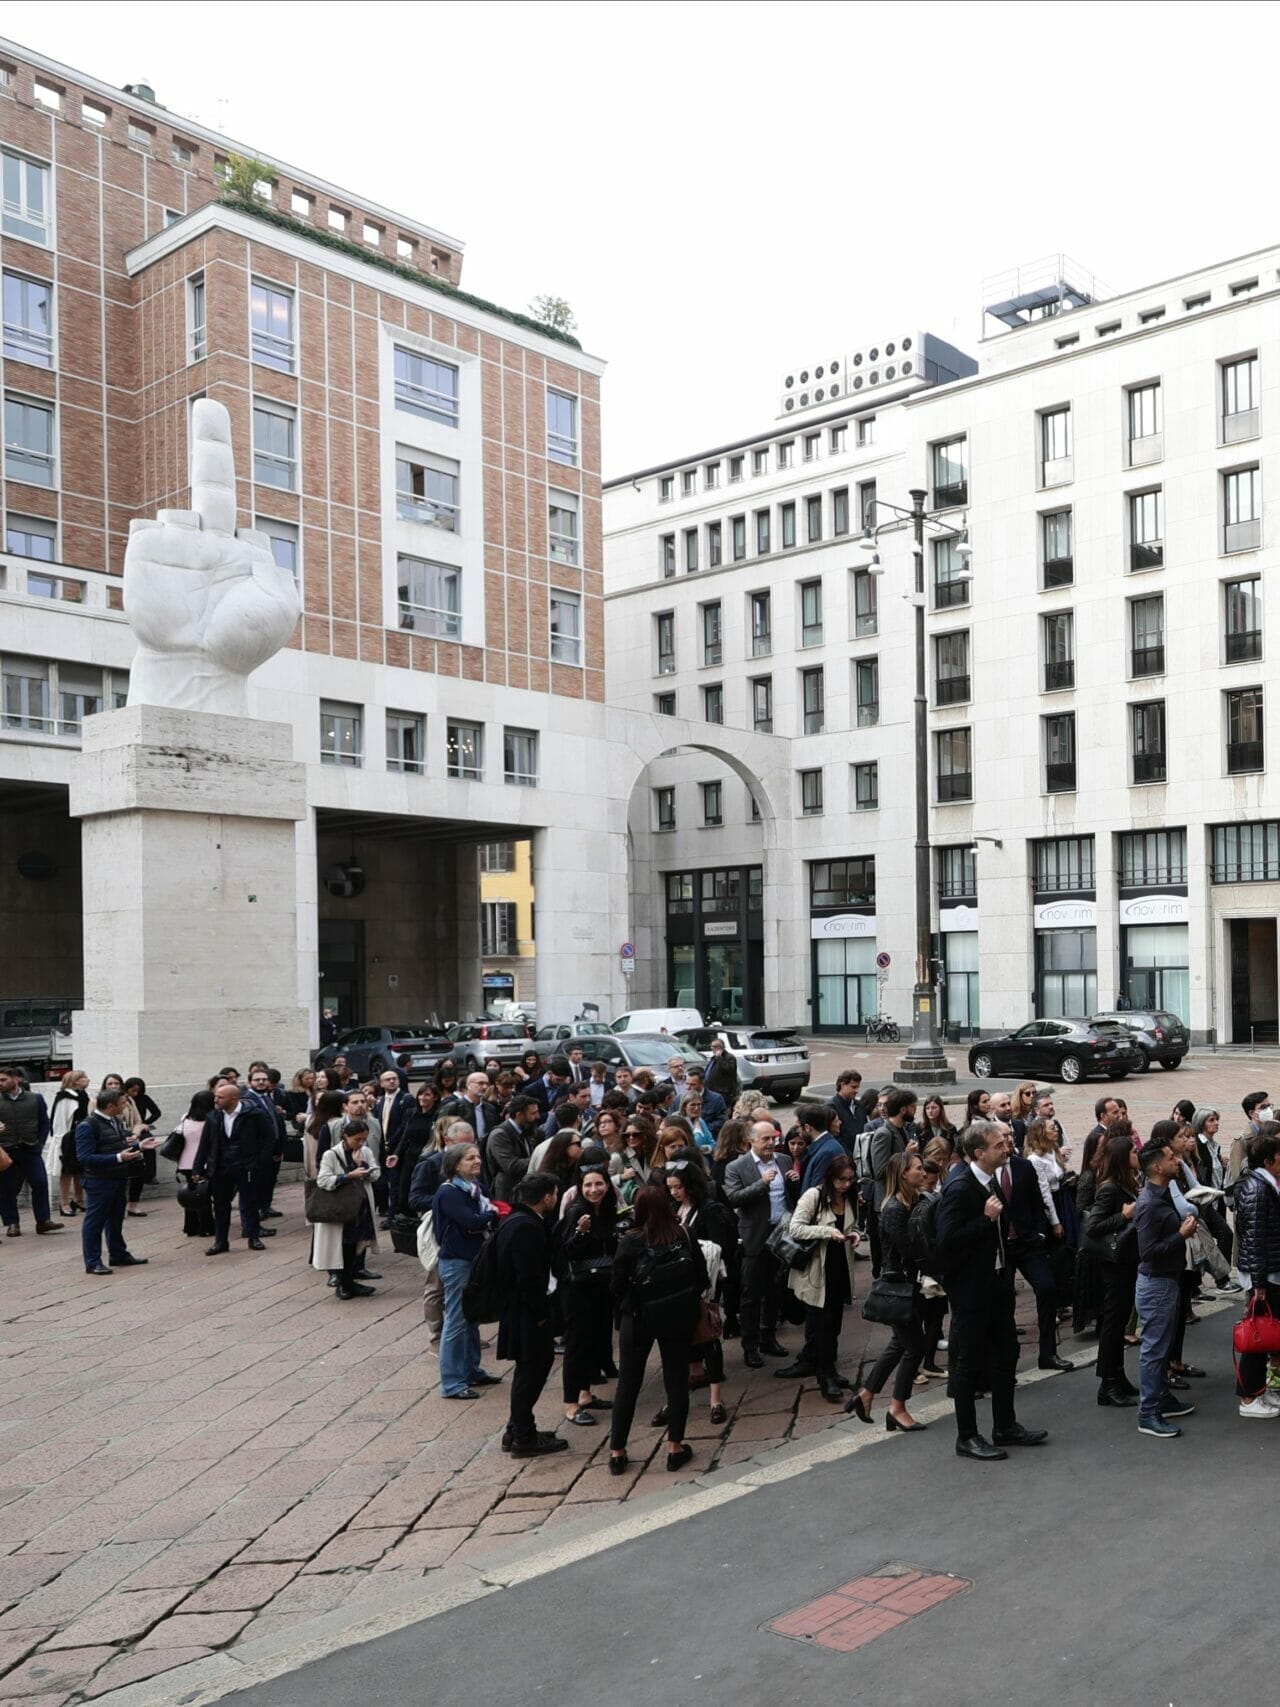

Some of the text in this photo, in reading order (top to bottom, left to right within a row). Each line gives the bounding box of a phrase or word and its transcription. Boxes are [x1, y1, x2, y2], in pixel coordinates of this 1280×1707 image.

[1046, 907, 1093, 920] novrim
[1133, 902, 1184, 916] novrim
[829, 921, 867, 932] novrim
